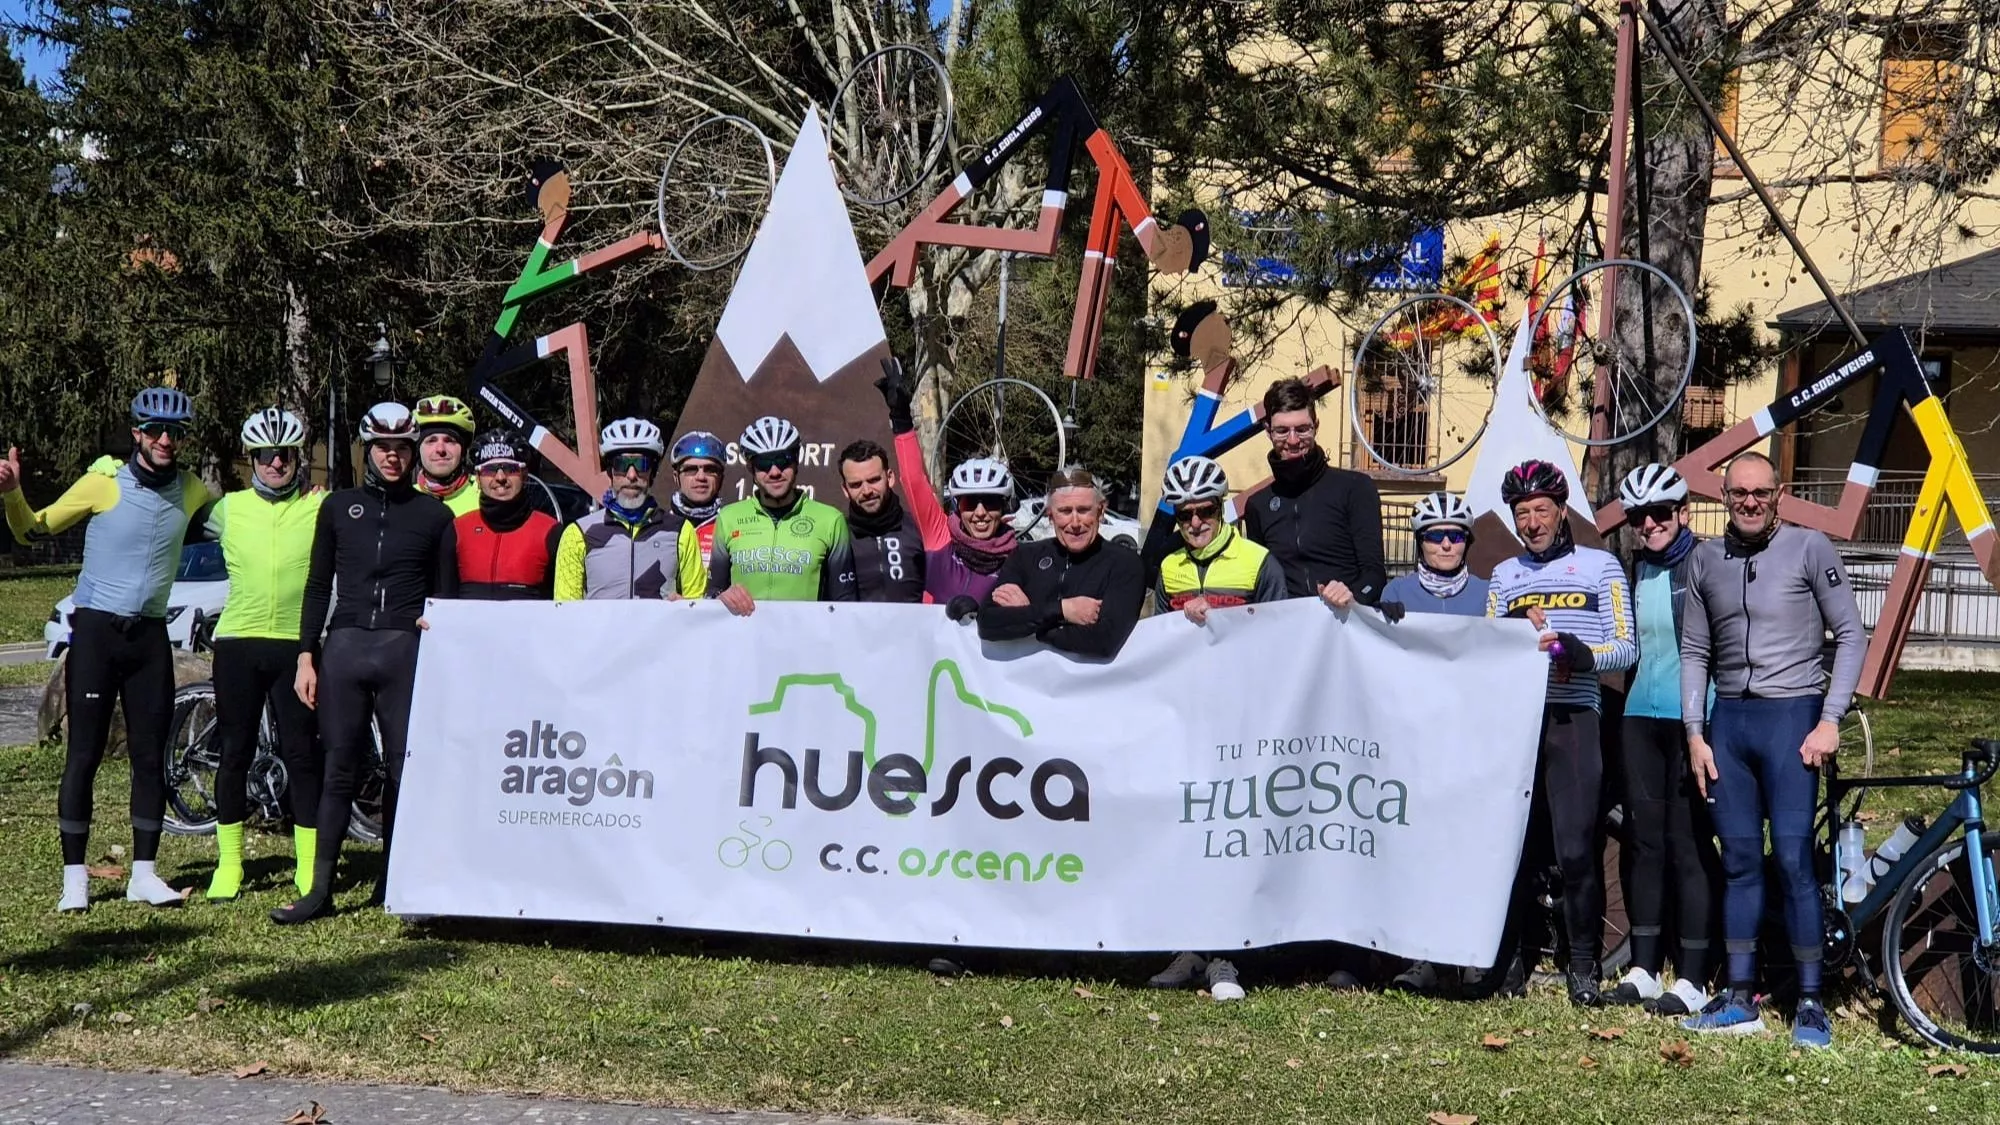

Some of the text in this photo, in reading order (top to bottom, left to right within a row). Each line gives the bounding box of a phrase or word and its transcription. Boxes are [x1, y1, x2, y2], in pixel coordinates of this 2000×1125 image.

[1791, 350, 1874, 407] C.C.EDELWEISS
[504, 720, 586, 760] alto
[739, 732, 1090, 822] huesca
[498, 810, 641, 829] SUPERMERCADOS
[898, 848, 1084, 883] oscense
